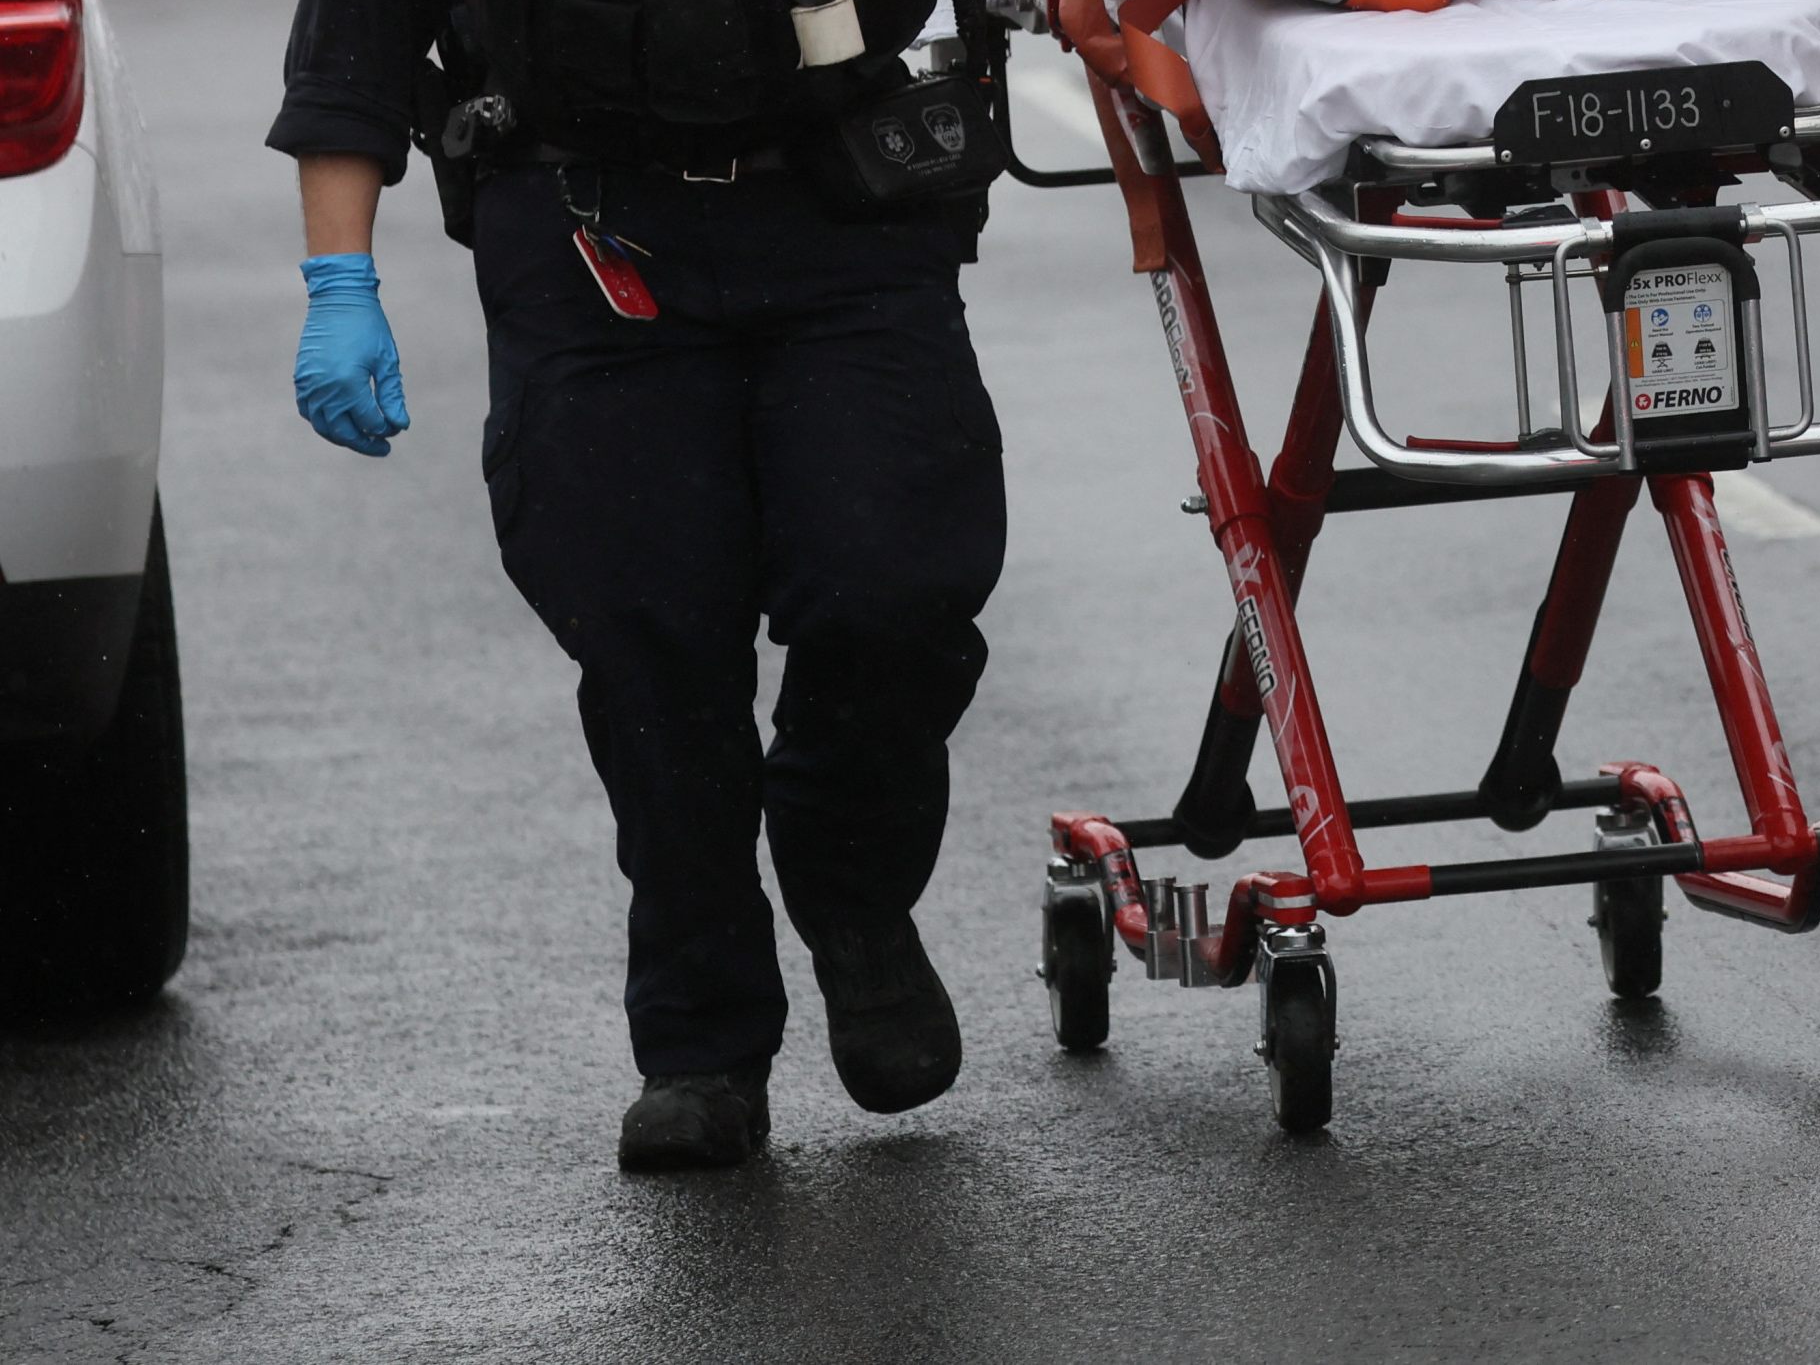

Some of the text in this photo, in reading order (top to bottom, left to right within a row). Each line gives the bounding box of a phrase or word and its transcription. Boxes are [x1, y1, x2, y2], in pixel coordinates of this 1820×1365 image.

[1654, 271, 1723, 289] PROFlexx
[1653, 386, 1723, 410] FERNO
[1238, 598, 1275, 699] FERNO
